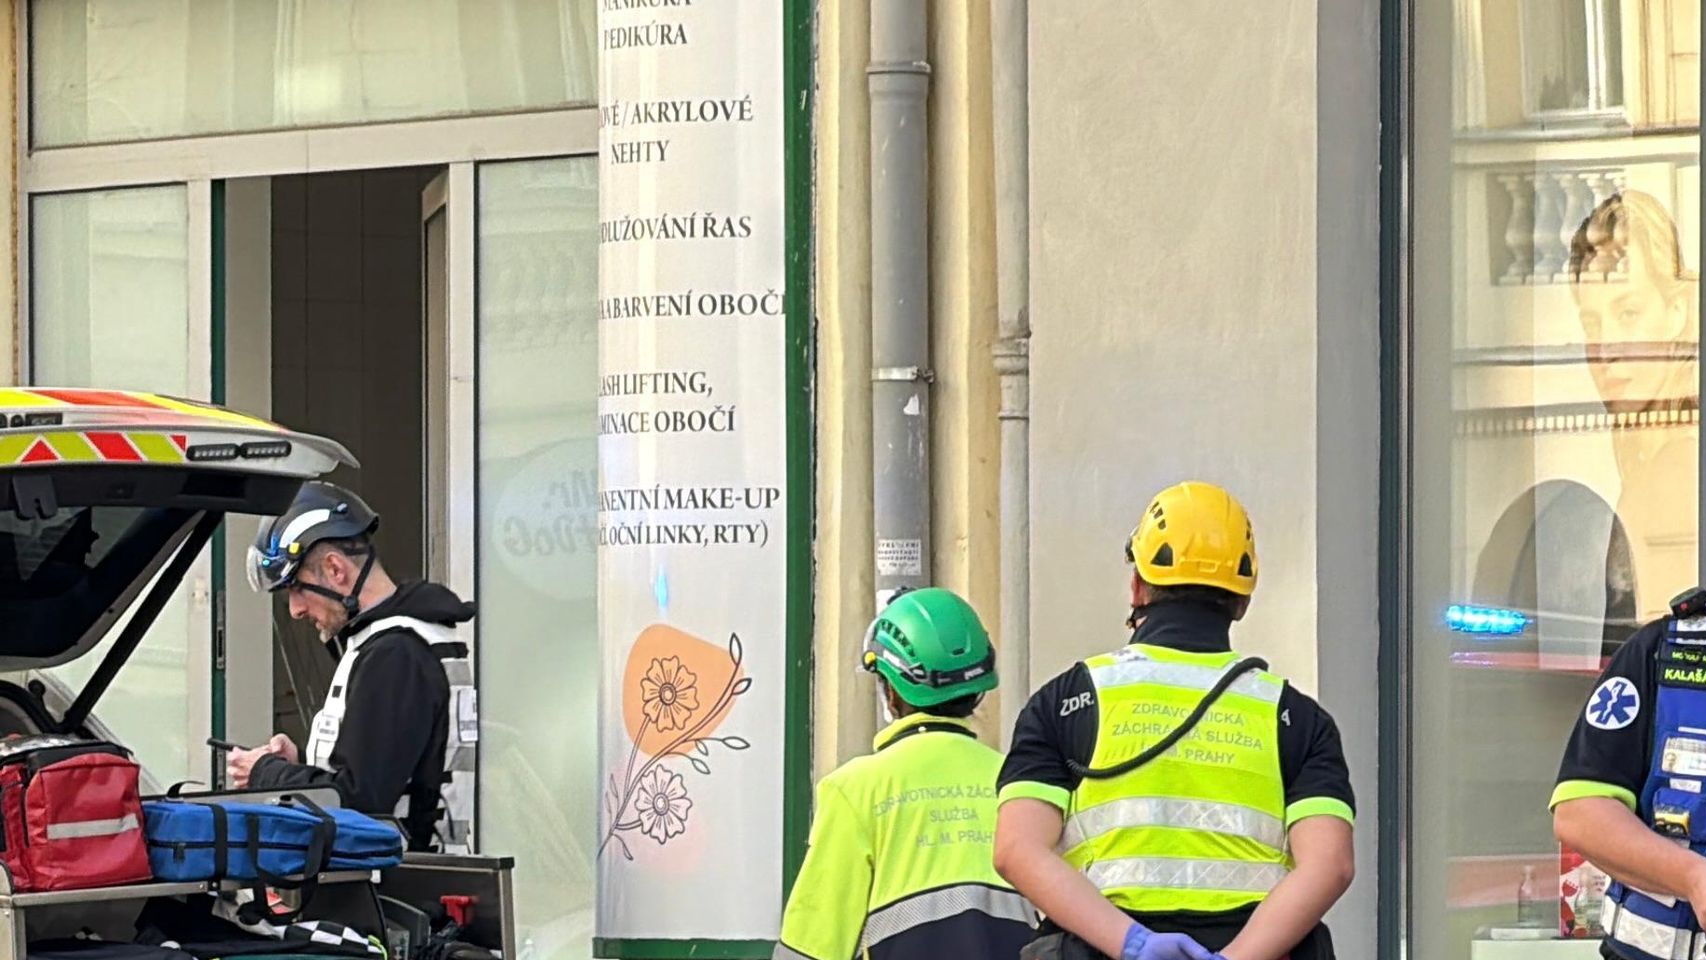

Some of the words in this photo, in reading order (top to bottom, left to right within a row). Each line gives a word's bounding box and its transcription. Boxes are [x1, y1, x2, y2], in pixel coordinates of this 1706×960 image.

[631, 95, 754, 125] AKRYLOVÉ
[611, 140, 670, 165] NEHTY
[702, 212, 752, 239] ŘAS
[654, 406, 736, 433] OBOČÍ
[665, 487, 780, 510] MAKE-UP
[646, 524, 708, 548] LINKY,
[714, 520, 769, 548] RTY)
[1206, 730, 1263, 751] SLUŽBA
[1185, 749, 1235, 765] PRAHY
[929, 806, 979, 823] SLUŽBA
[958, 830, 993, 844] PRAH
